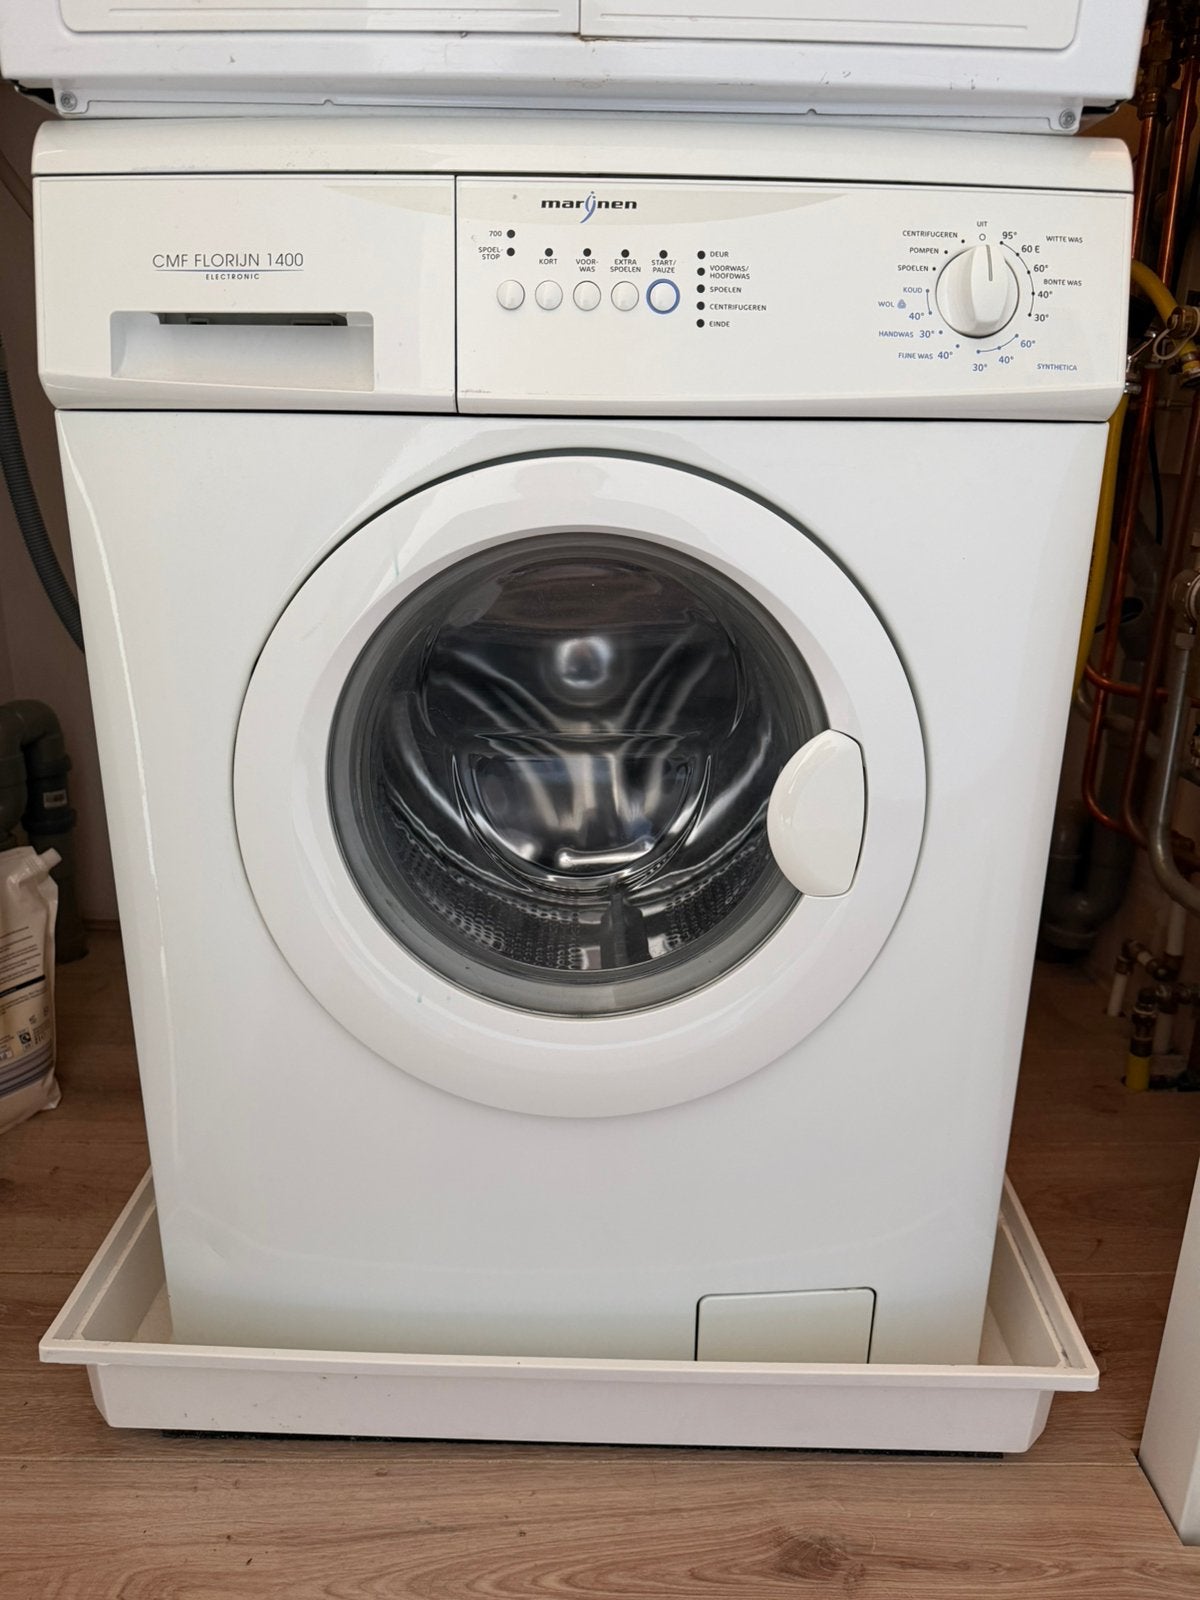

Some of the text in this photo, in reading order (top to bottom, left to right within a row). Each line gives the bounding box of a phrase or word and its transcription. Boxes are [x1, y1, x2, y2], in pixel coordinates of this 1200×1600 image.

[902, 230, 958, 238] CENTRIFUGEREN
[1002, 231, 1017, 239] 95°
[1021, 245, 1040, 253] 60 E
[152, 253, 304, 268] CMF FLORIJN 1400
[1033, 264, 1048, 272] 60°
[1038, 290, 1053, 299] 40°
[909, 312, 924, 320] 40°
[1034, 314, 1049, 322] 30°
[920, 330, 935, 338] 30°
[1020, 340, 1036, 348] 60°
[937, 351, 953, 359] 40°
[998, 355, 1014, 364] 40°
[972, 363, 987, 372] 30°
